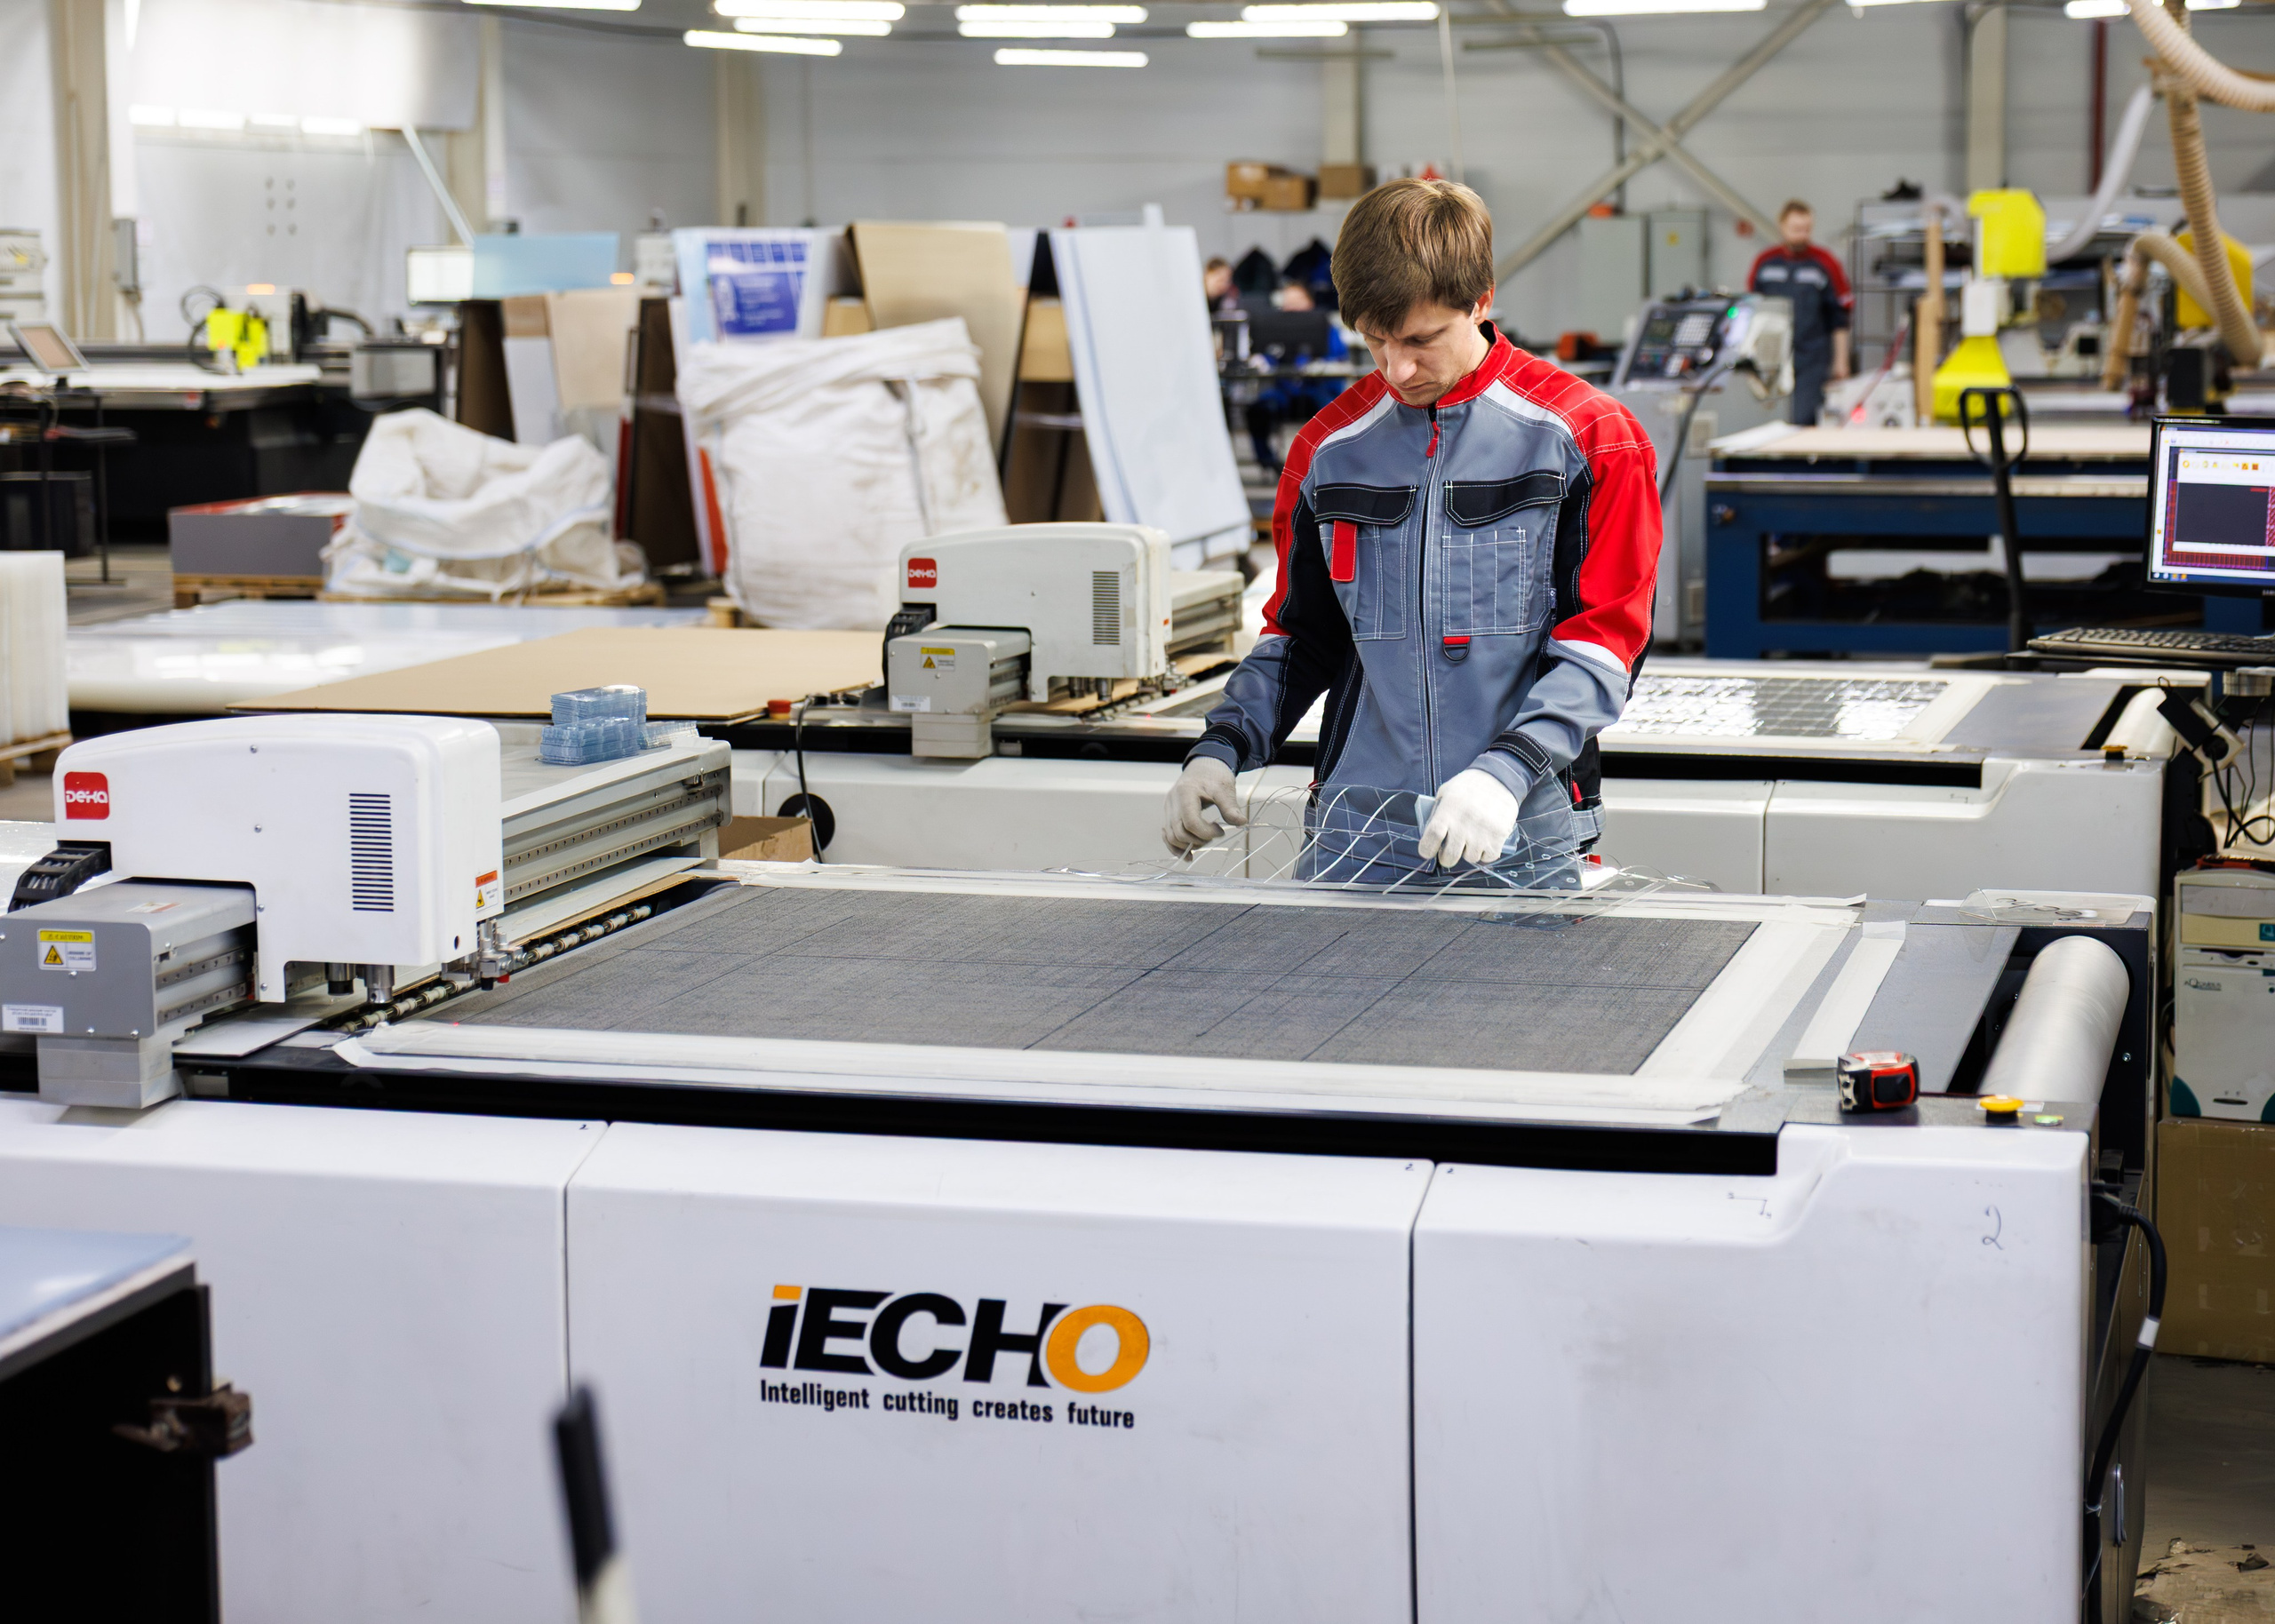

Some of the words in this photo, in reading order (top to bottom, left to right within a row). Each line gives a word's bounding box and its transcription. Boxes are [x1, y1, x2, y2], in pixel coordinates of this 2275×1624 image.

[1982, 1205, 2004, 1250] 2
[760, 1379, 870, 1412] Intelligent
[882, 1392, 959, 1420] cutting
[973, 1397, 1054, 1422] creates
[1067, 1402, 1135, 1429] future
